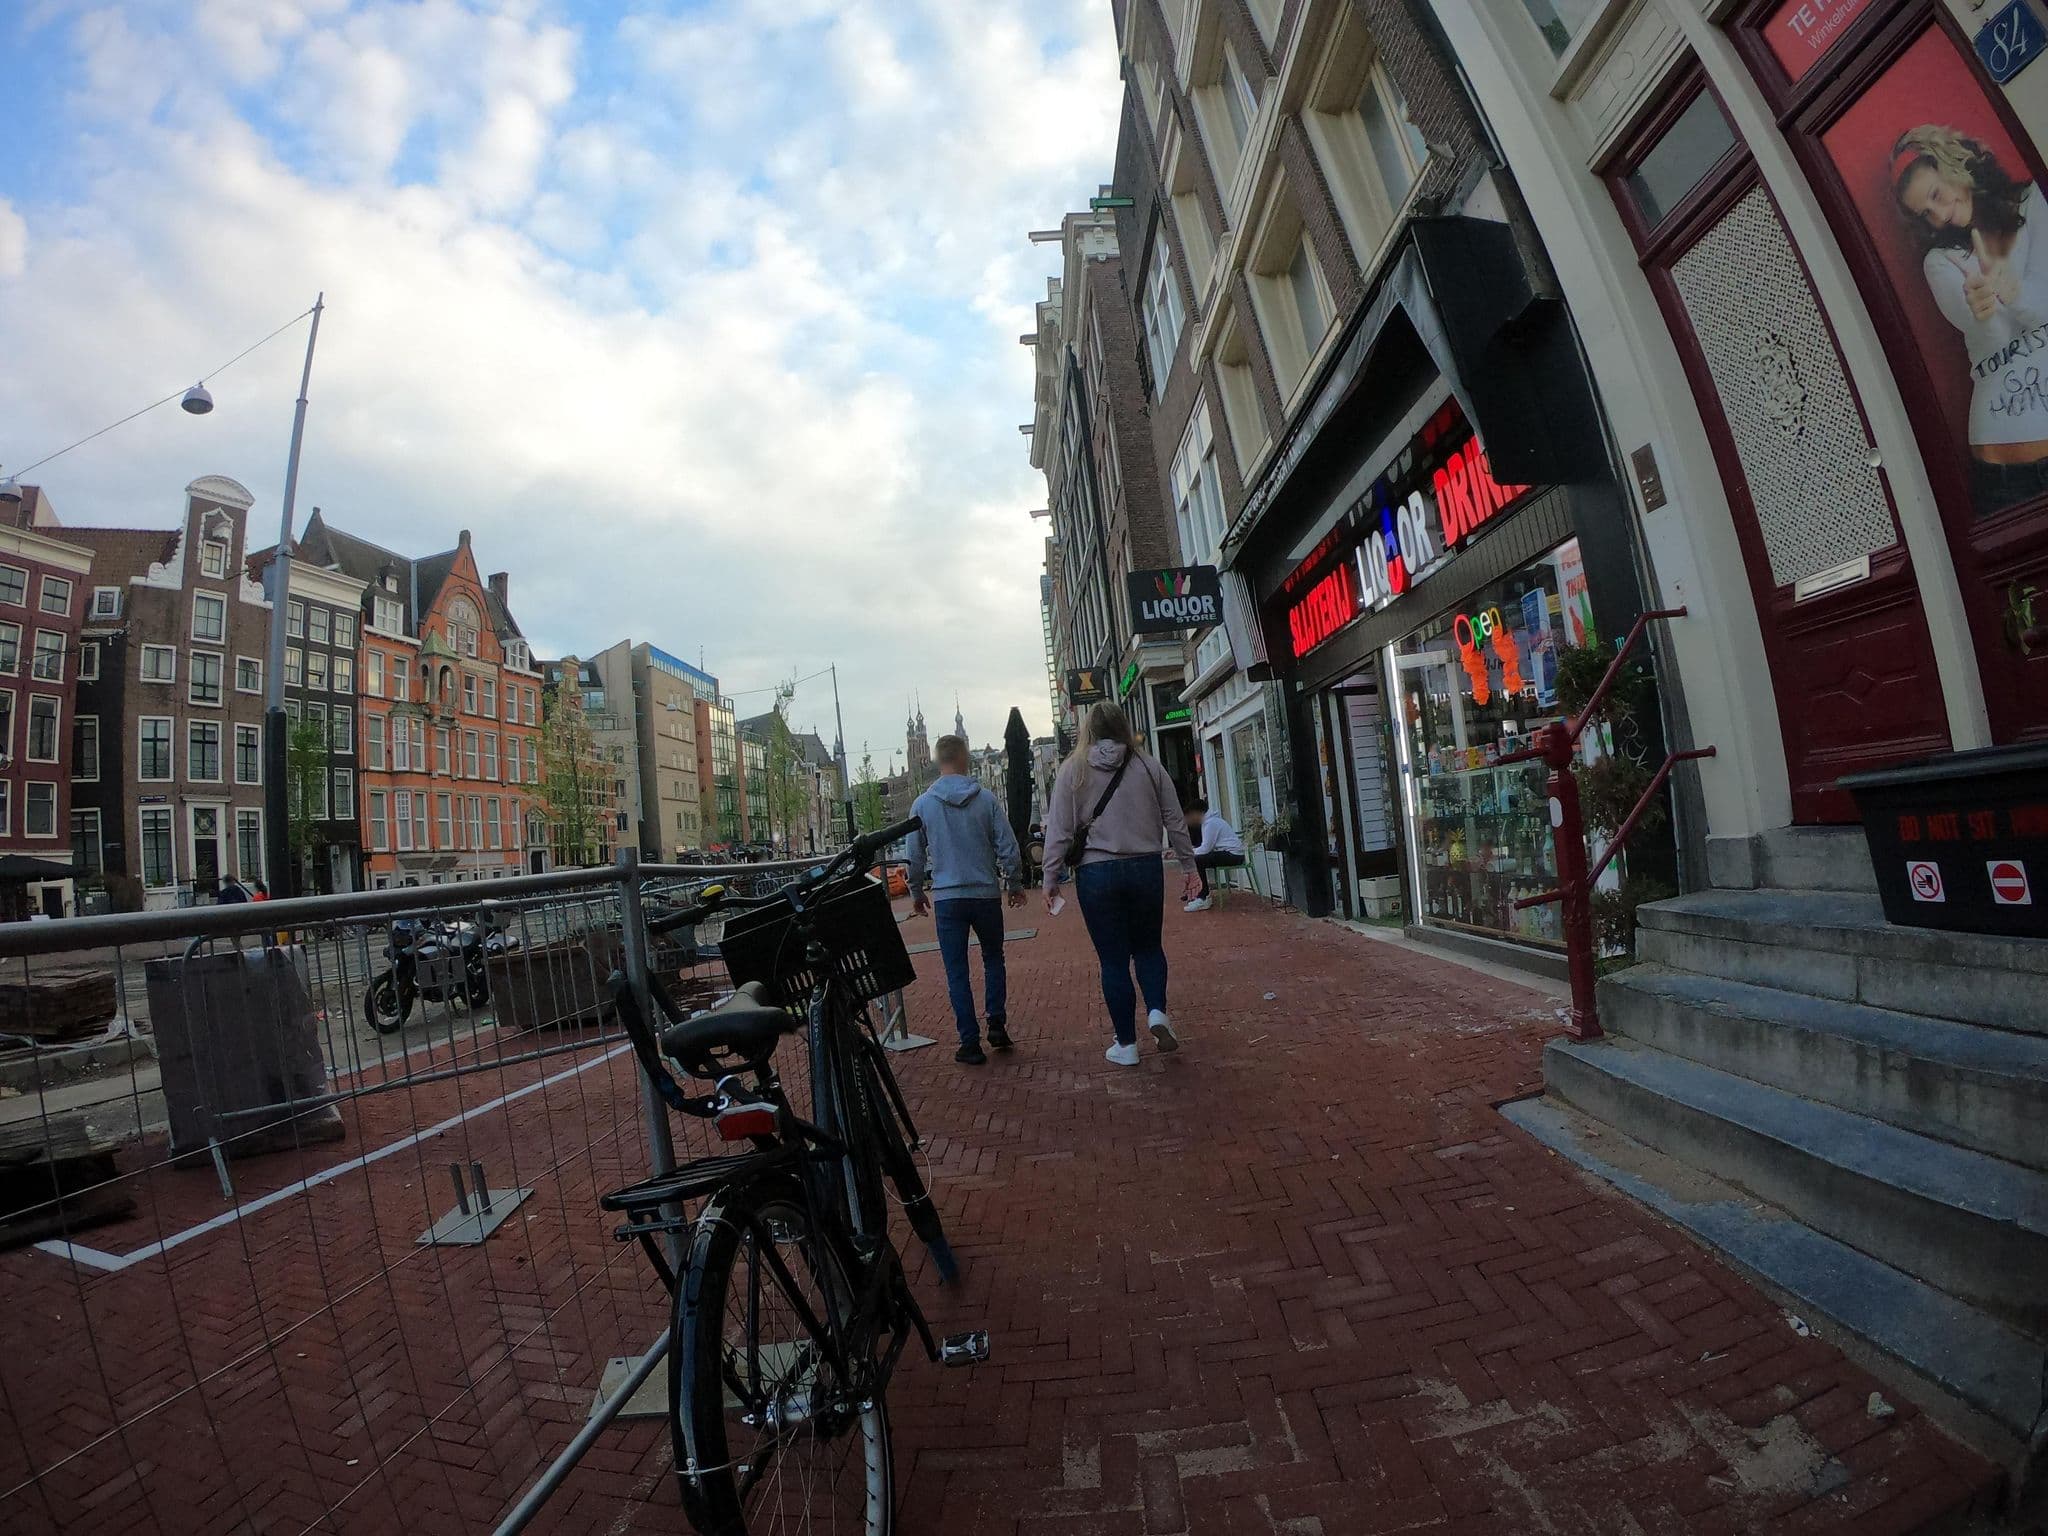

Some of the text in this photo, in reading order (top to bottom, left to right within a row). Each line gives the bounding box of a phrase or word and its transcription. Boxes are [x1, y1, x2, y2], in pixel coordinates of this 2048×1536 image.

[1787, 3, 1816, 36] TE
[1990, 7, 2029, 72] 84
[2004, 367, 2039, 393] GO
[1289, 562, 1351, 657] SLIJTERIJ
[1355, 489, 1435, 608] LIQUOR
[1142, 595, 1216, 620] LIQUOR
[1176, 613, 1217, 624] STORE
[1454, 607, 1504, 652] Open
